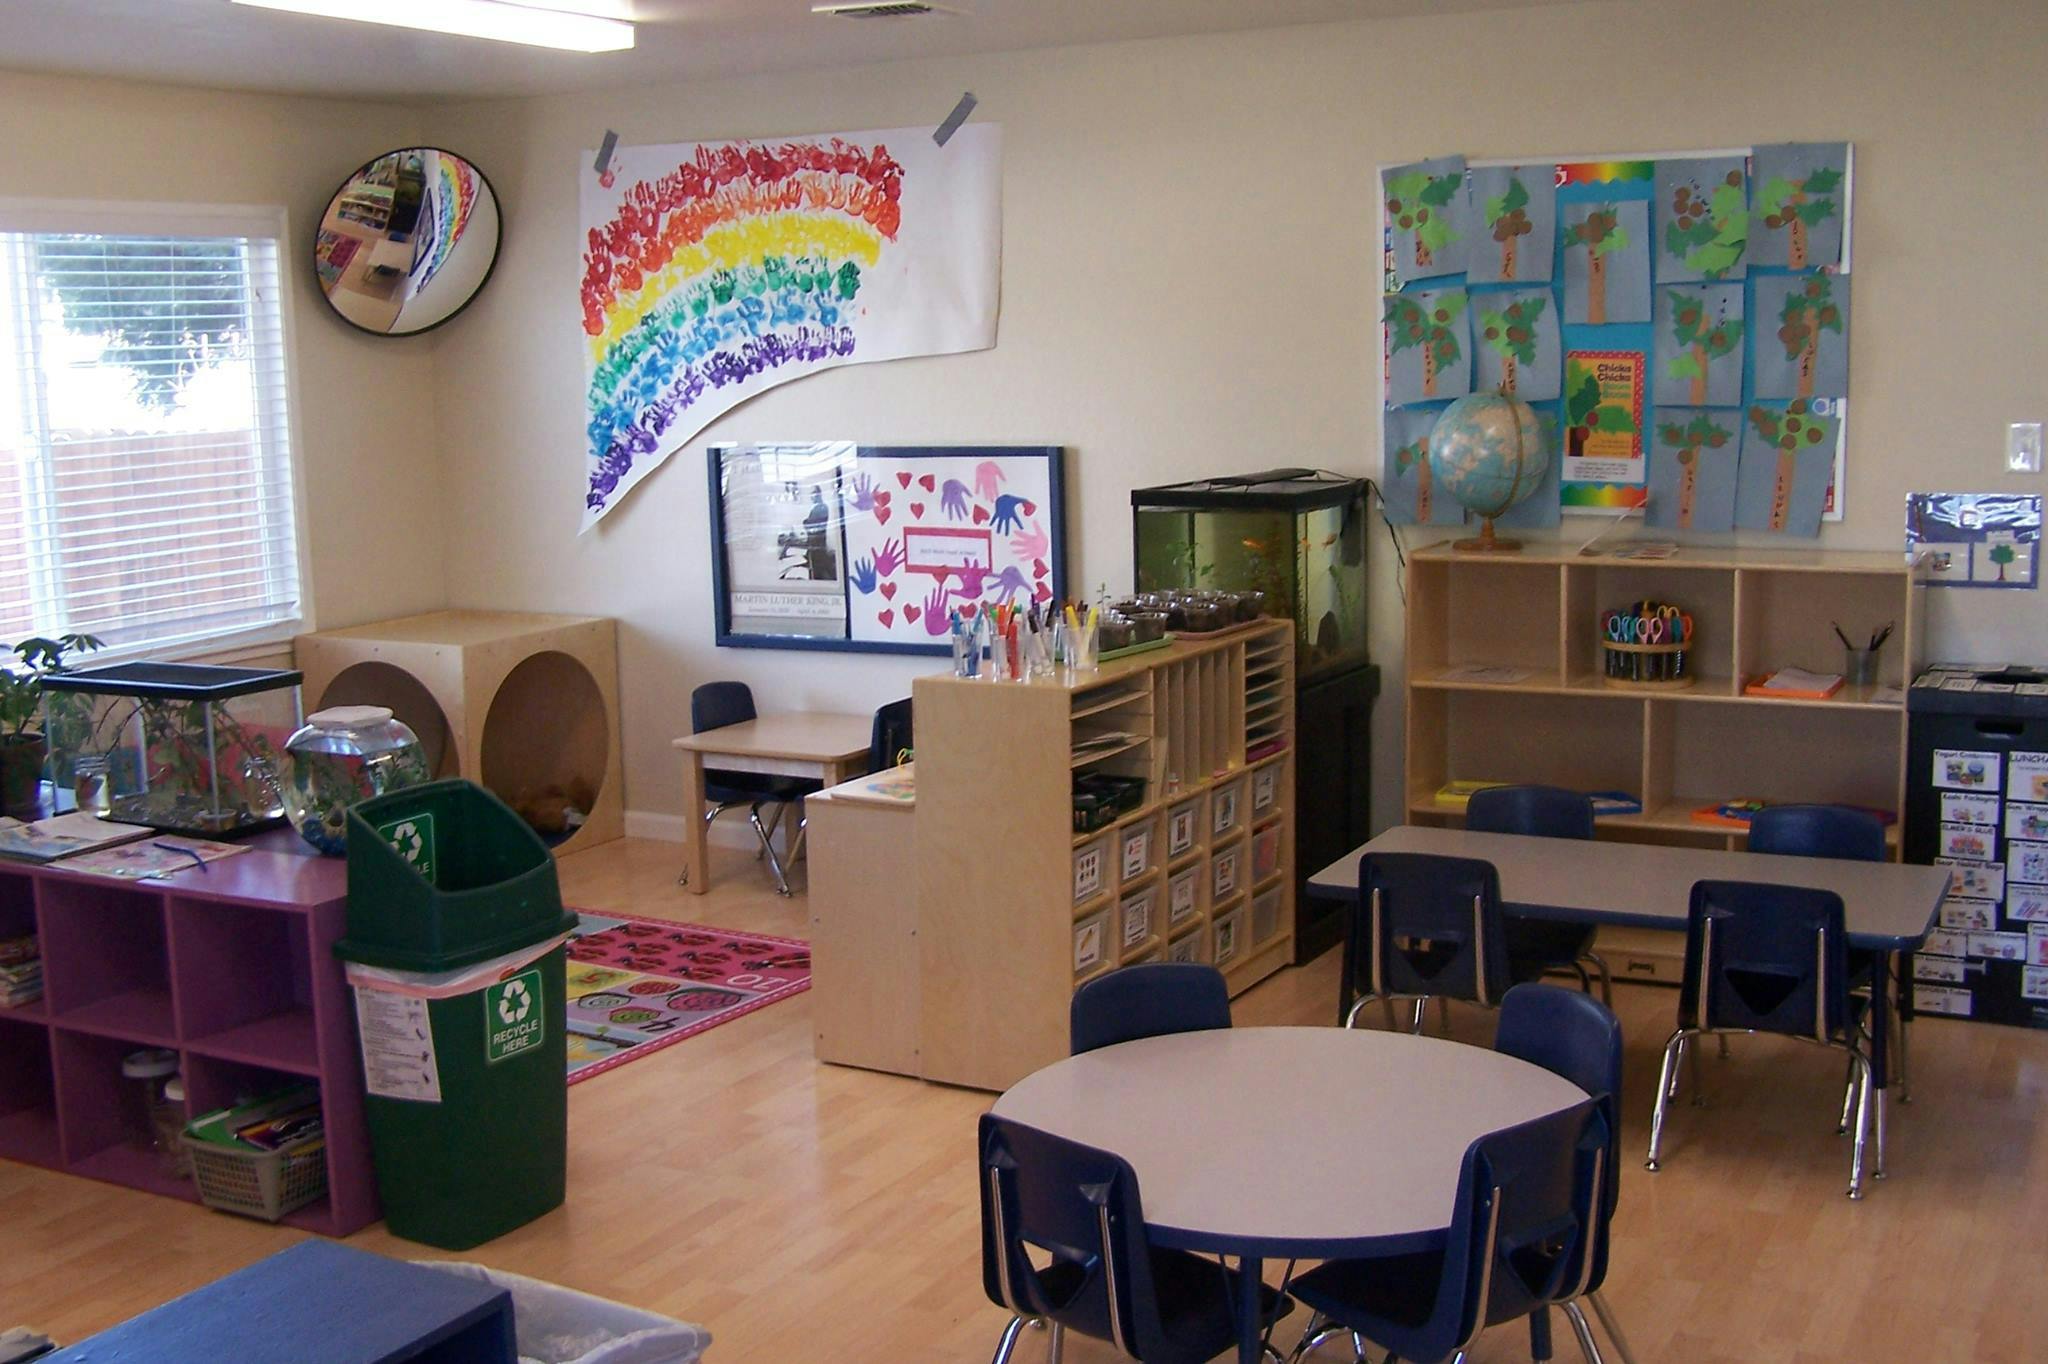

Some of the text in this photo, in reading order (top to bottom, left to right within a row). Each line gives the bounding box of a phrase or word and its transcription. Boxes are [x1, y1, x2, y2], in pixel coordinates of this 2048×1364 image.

[735, 593, 768, 605] MARTIN
[770, 595, 803, 606] LUTHER
[493, 1018, 539, 1045] RECYCLE
[502, 1034, 529, 1054] HERE
